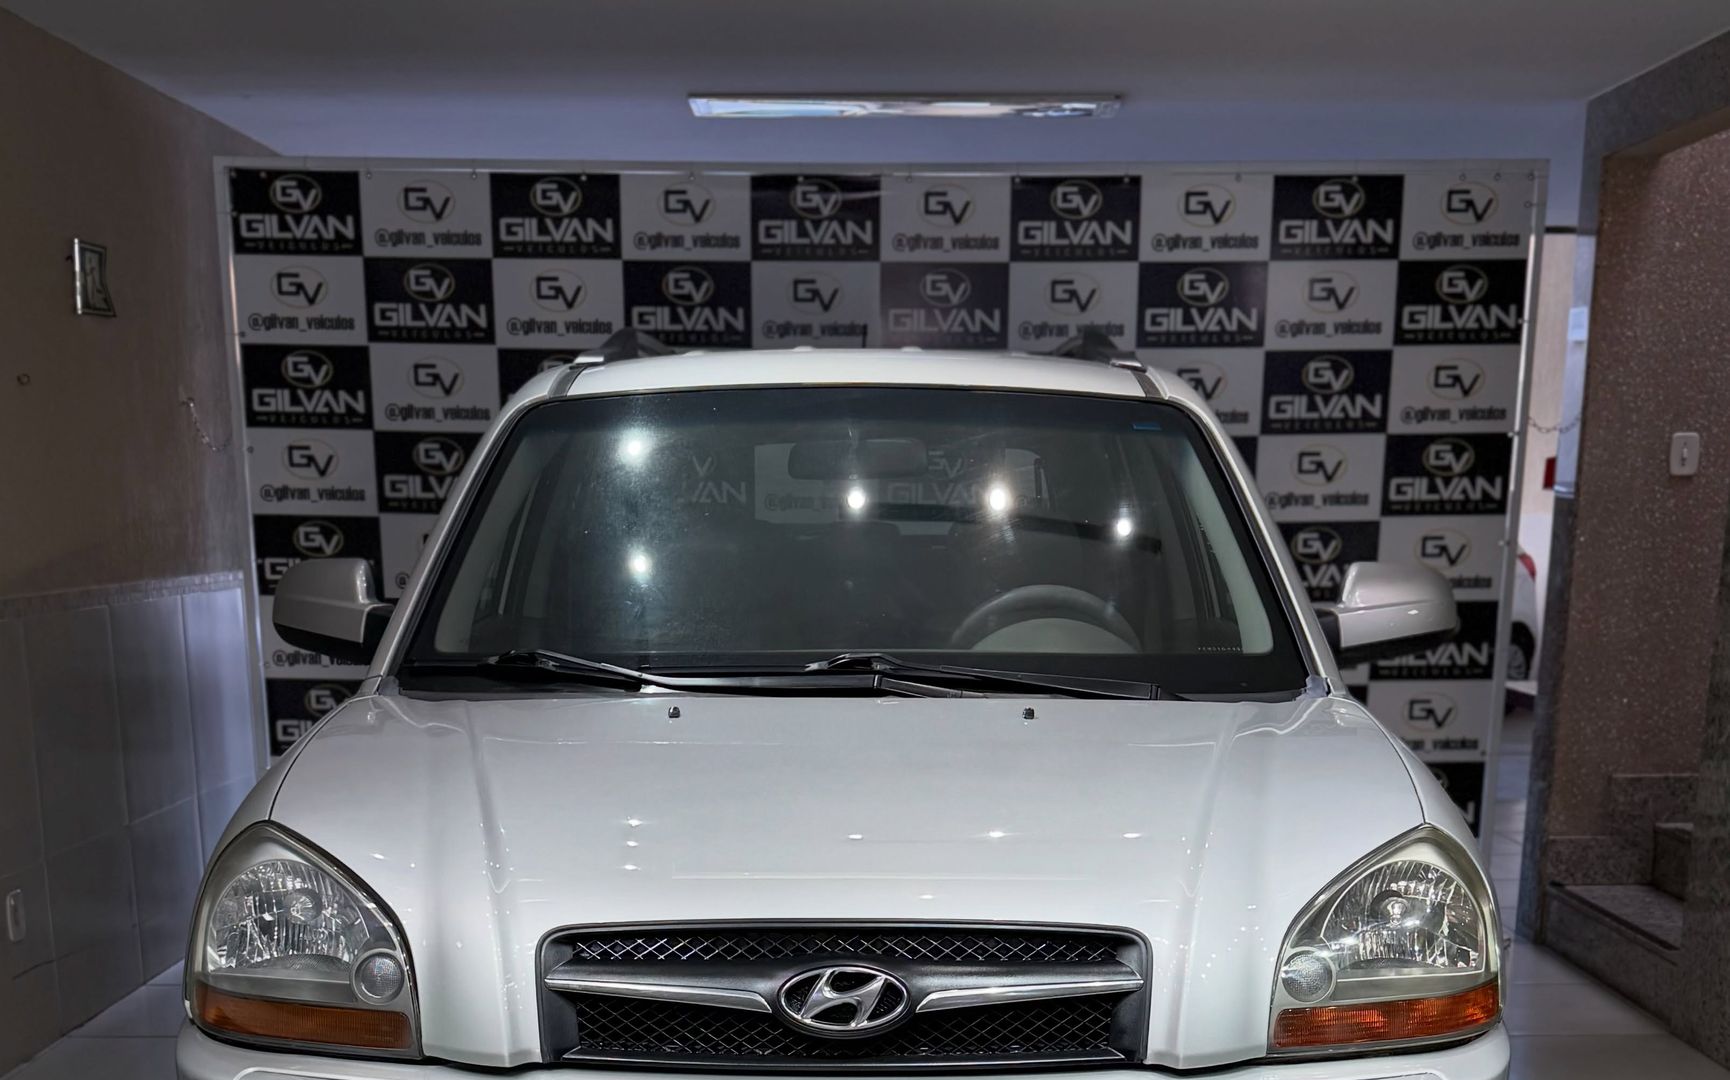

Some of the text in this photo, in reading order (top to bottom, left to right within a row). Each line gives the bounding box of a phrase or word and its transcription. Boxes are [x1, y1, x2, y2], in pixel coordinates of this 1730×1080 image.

[273, 179, 317, 212] GV
[404, 187, 451, 220] GV
[536, 182, 579, 213] GV
[664, 189, 711, 223] GV
[796, 186, 839, 217] GV
[924, 191, 970, 225] GV
[1056, 186, 1099, 216] GV
[1185, 189, 1232, 224] GV
[1319, 184, 1362, 214] GV
[1448, 187, 1493, 221] GV
[240, 214, 355, 240] GILVAN
[501, 217, 613, 244] GILVAN
[759, 219, 872, 245] GILVAN
[1018, 220, 1132, 246] GILVAN
[1279, 219, 1394, 244] GILVAN
[277, 272, 323, 304] GV
[406, 269, 450, 299] GV
[537, 275, 582, 309] GV
[667, 271, 711, 302] GV
[793, 278, 838, 311] GV
[926, 274, 969, 304] GV
[1050, 279, 1096, 312] GV
[1183, 274, 1225, 304] GV
[1309, 277, 1355, 310] GV
[1442, 270, 1484, 300] GV
[374, 303, 487, 328] GILVAN
[632, 307, 744, 333] GILVAN
[889, 308, 1000, 333] GILVAN
[1145, 308, 1258, 332] GILVAN
[1402, 305, 1516, 330] GILVAN
[285, 356, 329, 386] GV
[414, 363, 459, 395] GV
[1308, 361, 1350, 391] GV
[1434, 365, 1480, 397] GV
[252, 389, 365, 414] GILVAN
[1269, 394, 1382, 418] GILVAN
[288, 446, 333, 476] GV
[418, 442, 458, 472] GV
[1298, 453, 1343, 482] GV
[1428, 444, 1470, 472] GV
[383, 474, 453, 499] GILV
[1390, 476, 1501, 501] GILVAN
[299, 527, 340, 556] GV
[1297, 532, 1336, 560] GV
[1421, 536, 1466, 566] GV
[1409, 699, 1452, 727] GV
